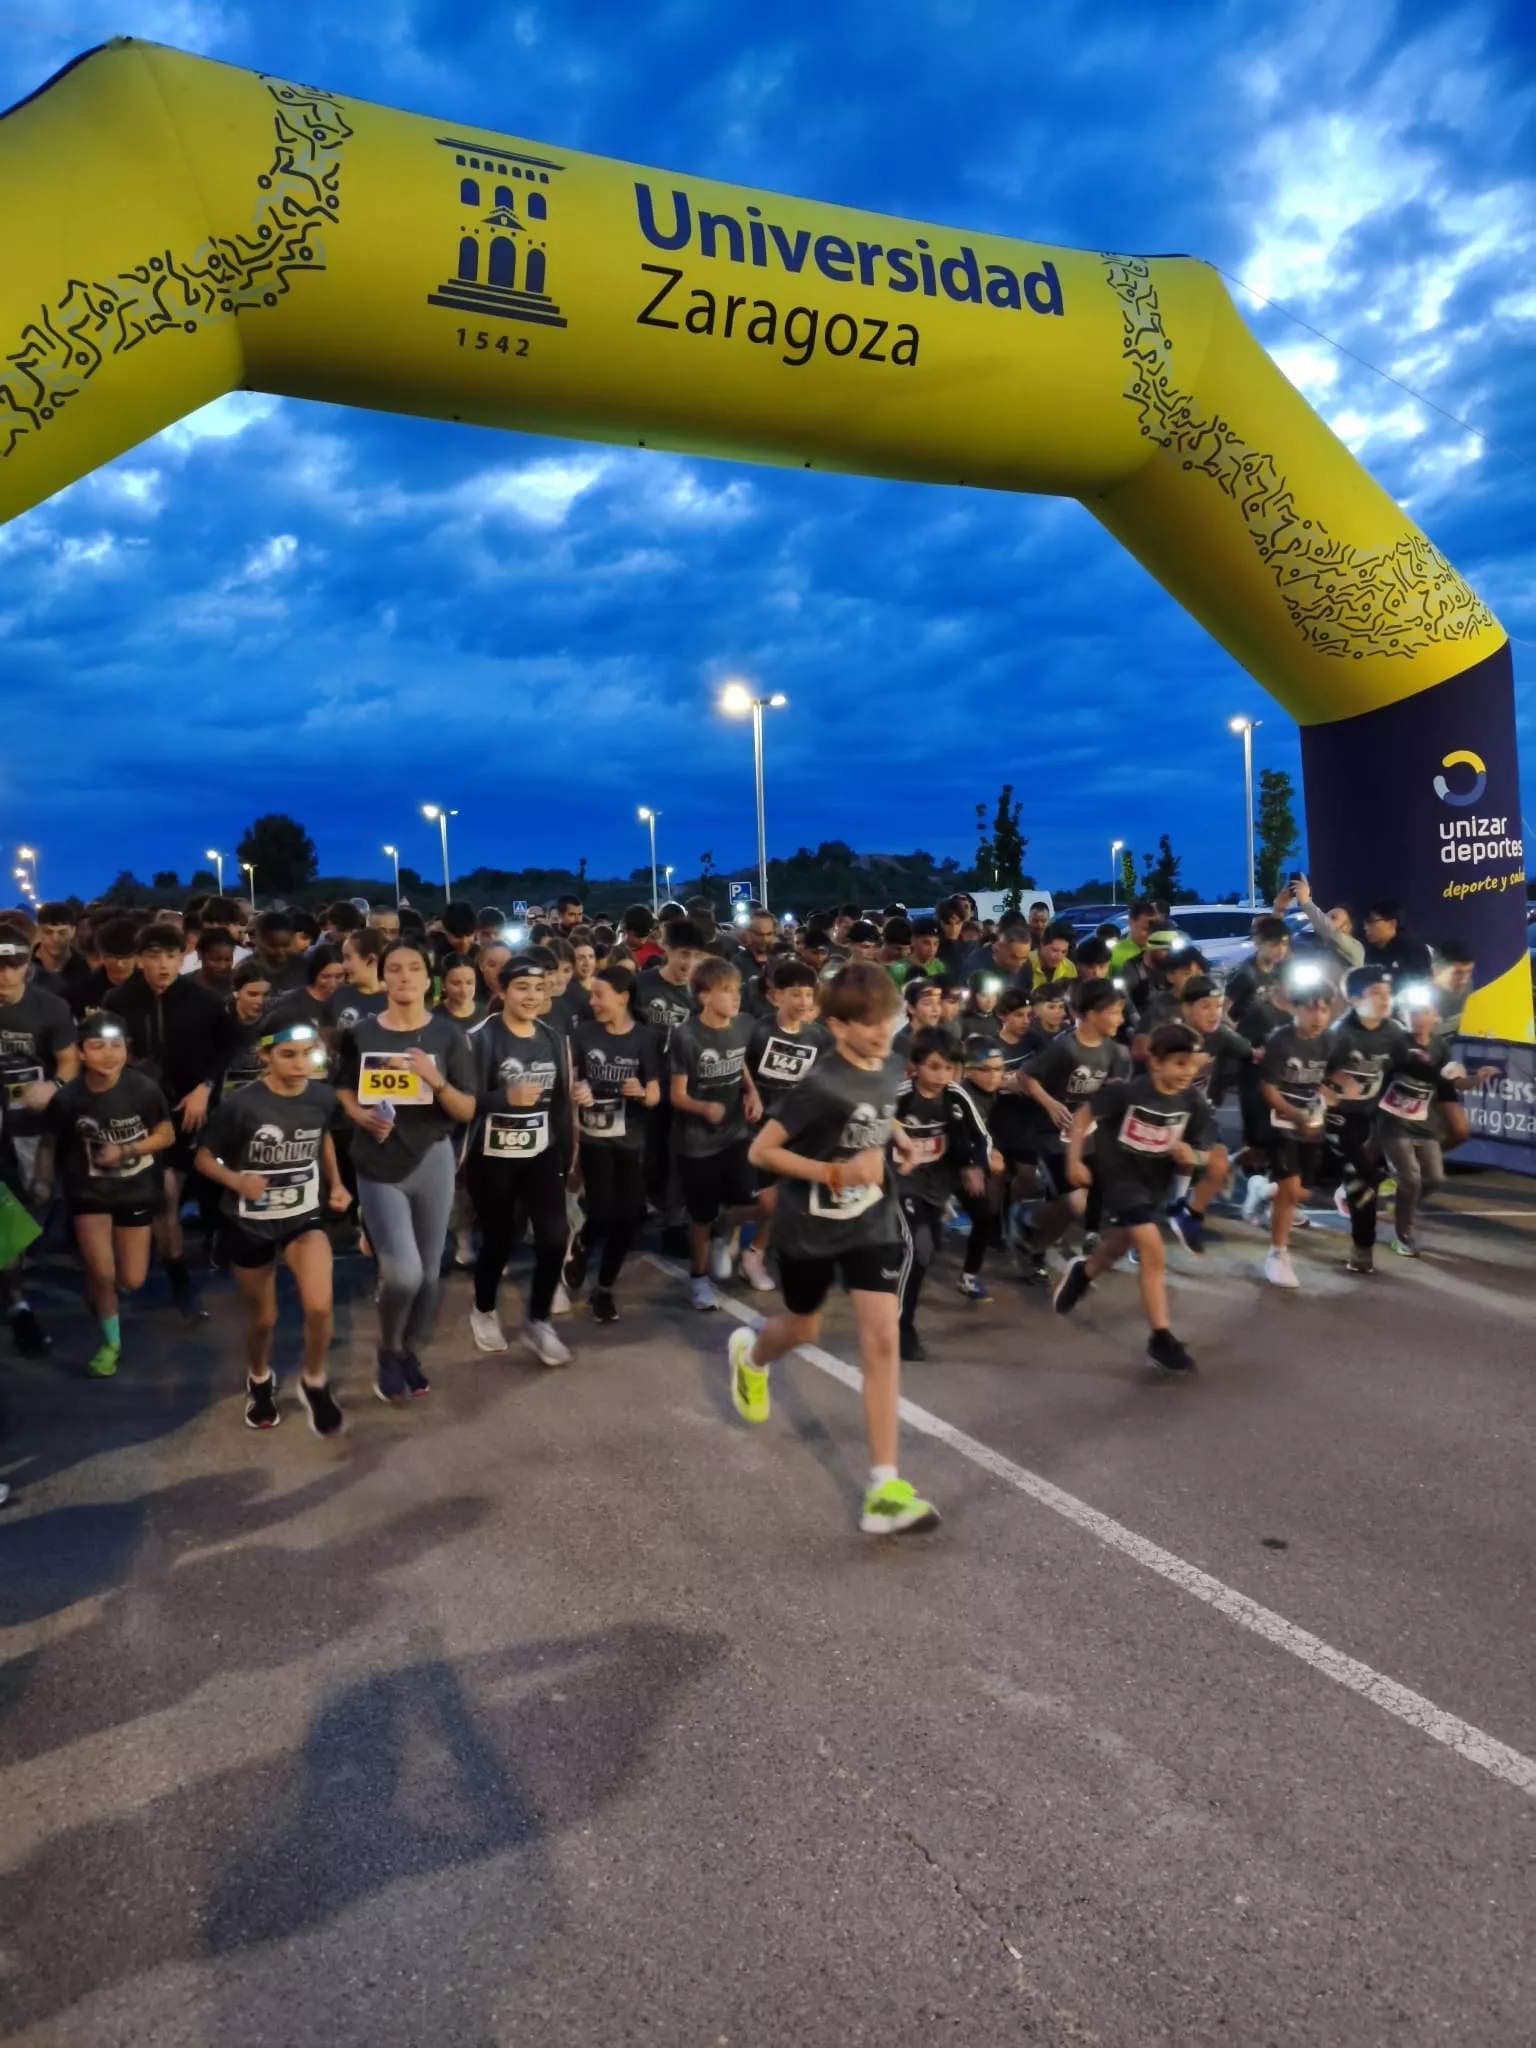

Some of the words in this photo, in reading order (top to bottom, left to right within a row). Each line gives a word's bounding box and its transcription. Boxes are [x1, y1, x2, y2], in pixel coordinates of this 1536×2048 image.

[633, 182, 1065, 317] Universidad
[636, 262, 921, 368] Zaragoza
[456, 327, 530, 358] 1542
[1439, 815, 1508, 840] unizar
[1440, 837, 1523, 865] deportes
[731, 884, 742, 898] P
[1442, 875, 1498, 901] deporte
[1499, 876, 1508, 893] y
[369, 1073, 410, 1090] 505
[497, 1131, 531, 1146] 160
